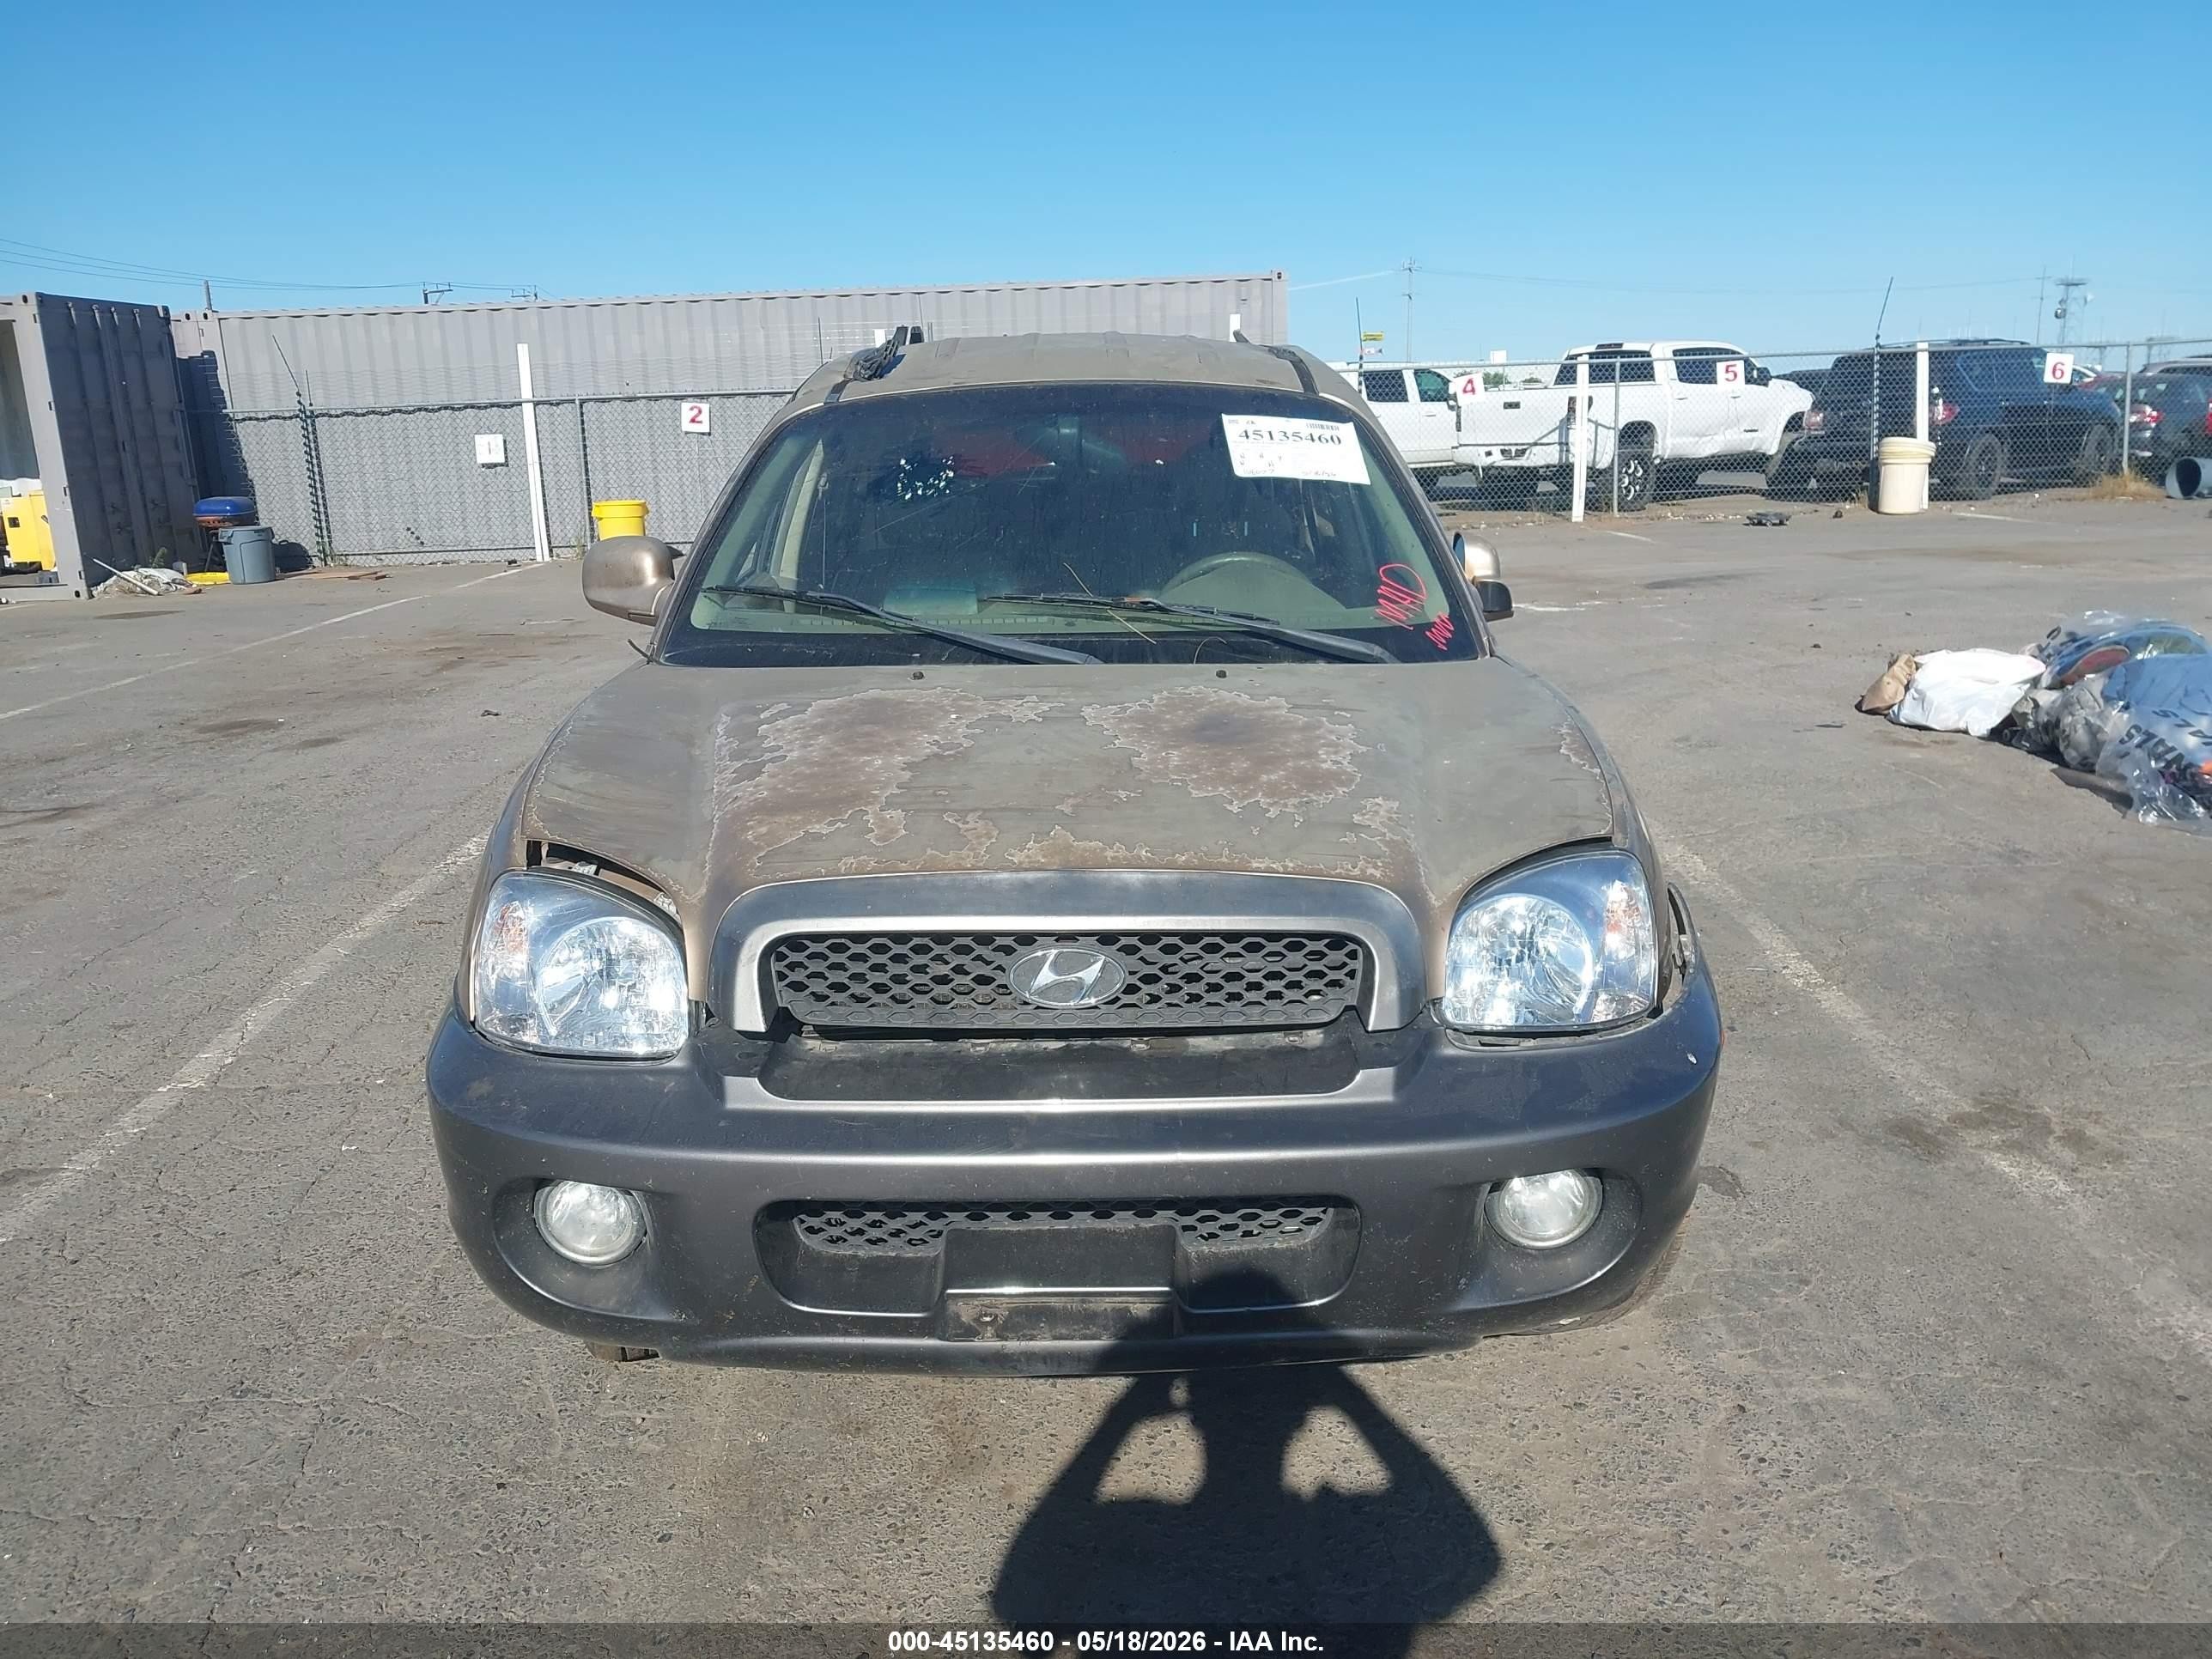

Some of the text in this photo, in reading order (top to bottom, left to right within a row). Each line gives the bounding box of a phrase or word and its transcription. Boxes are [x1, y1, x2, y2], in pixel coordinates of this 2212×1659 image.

[1724, 364, 1738, 382] 5
[2052, 362, 2065, 380] 6
[1462, 378, 1476, 396] 4
[689, 405, 704, 424] 2
[1238, 428, 1342, 446] 45135460
